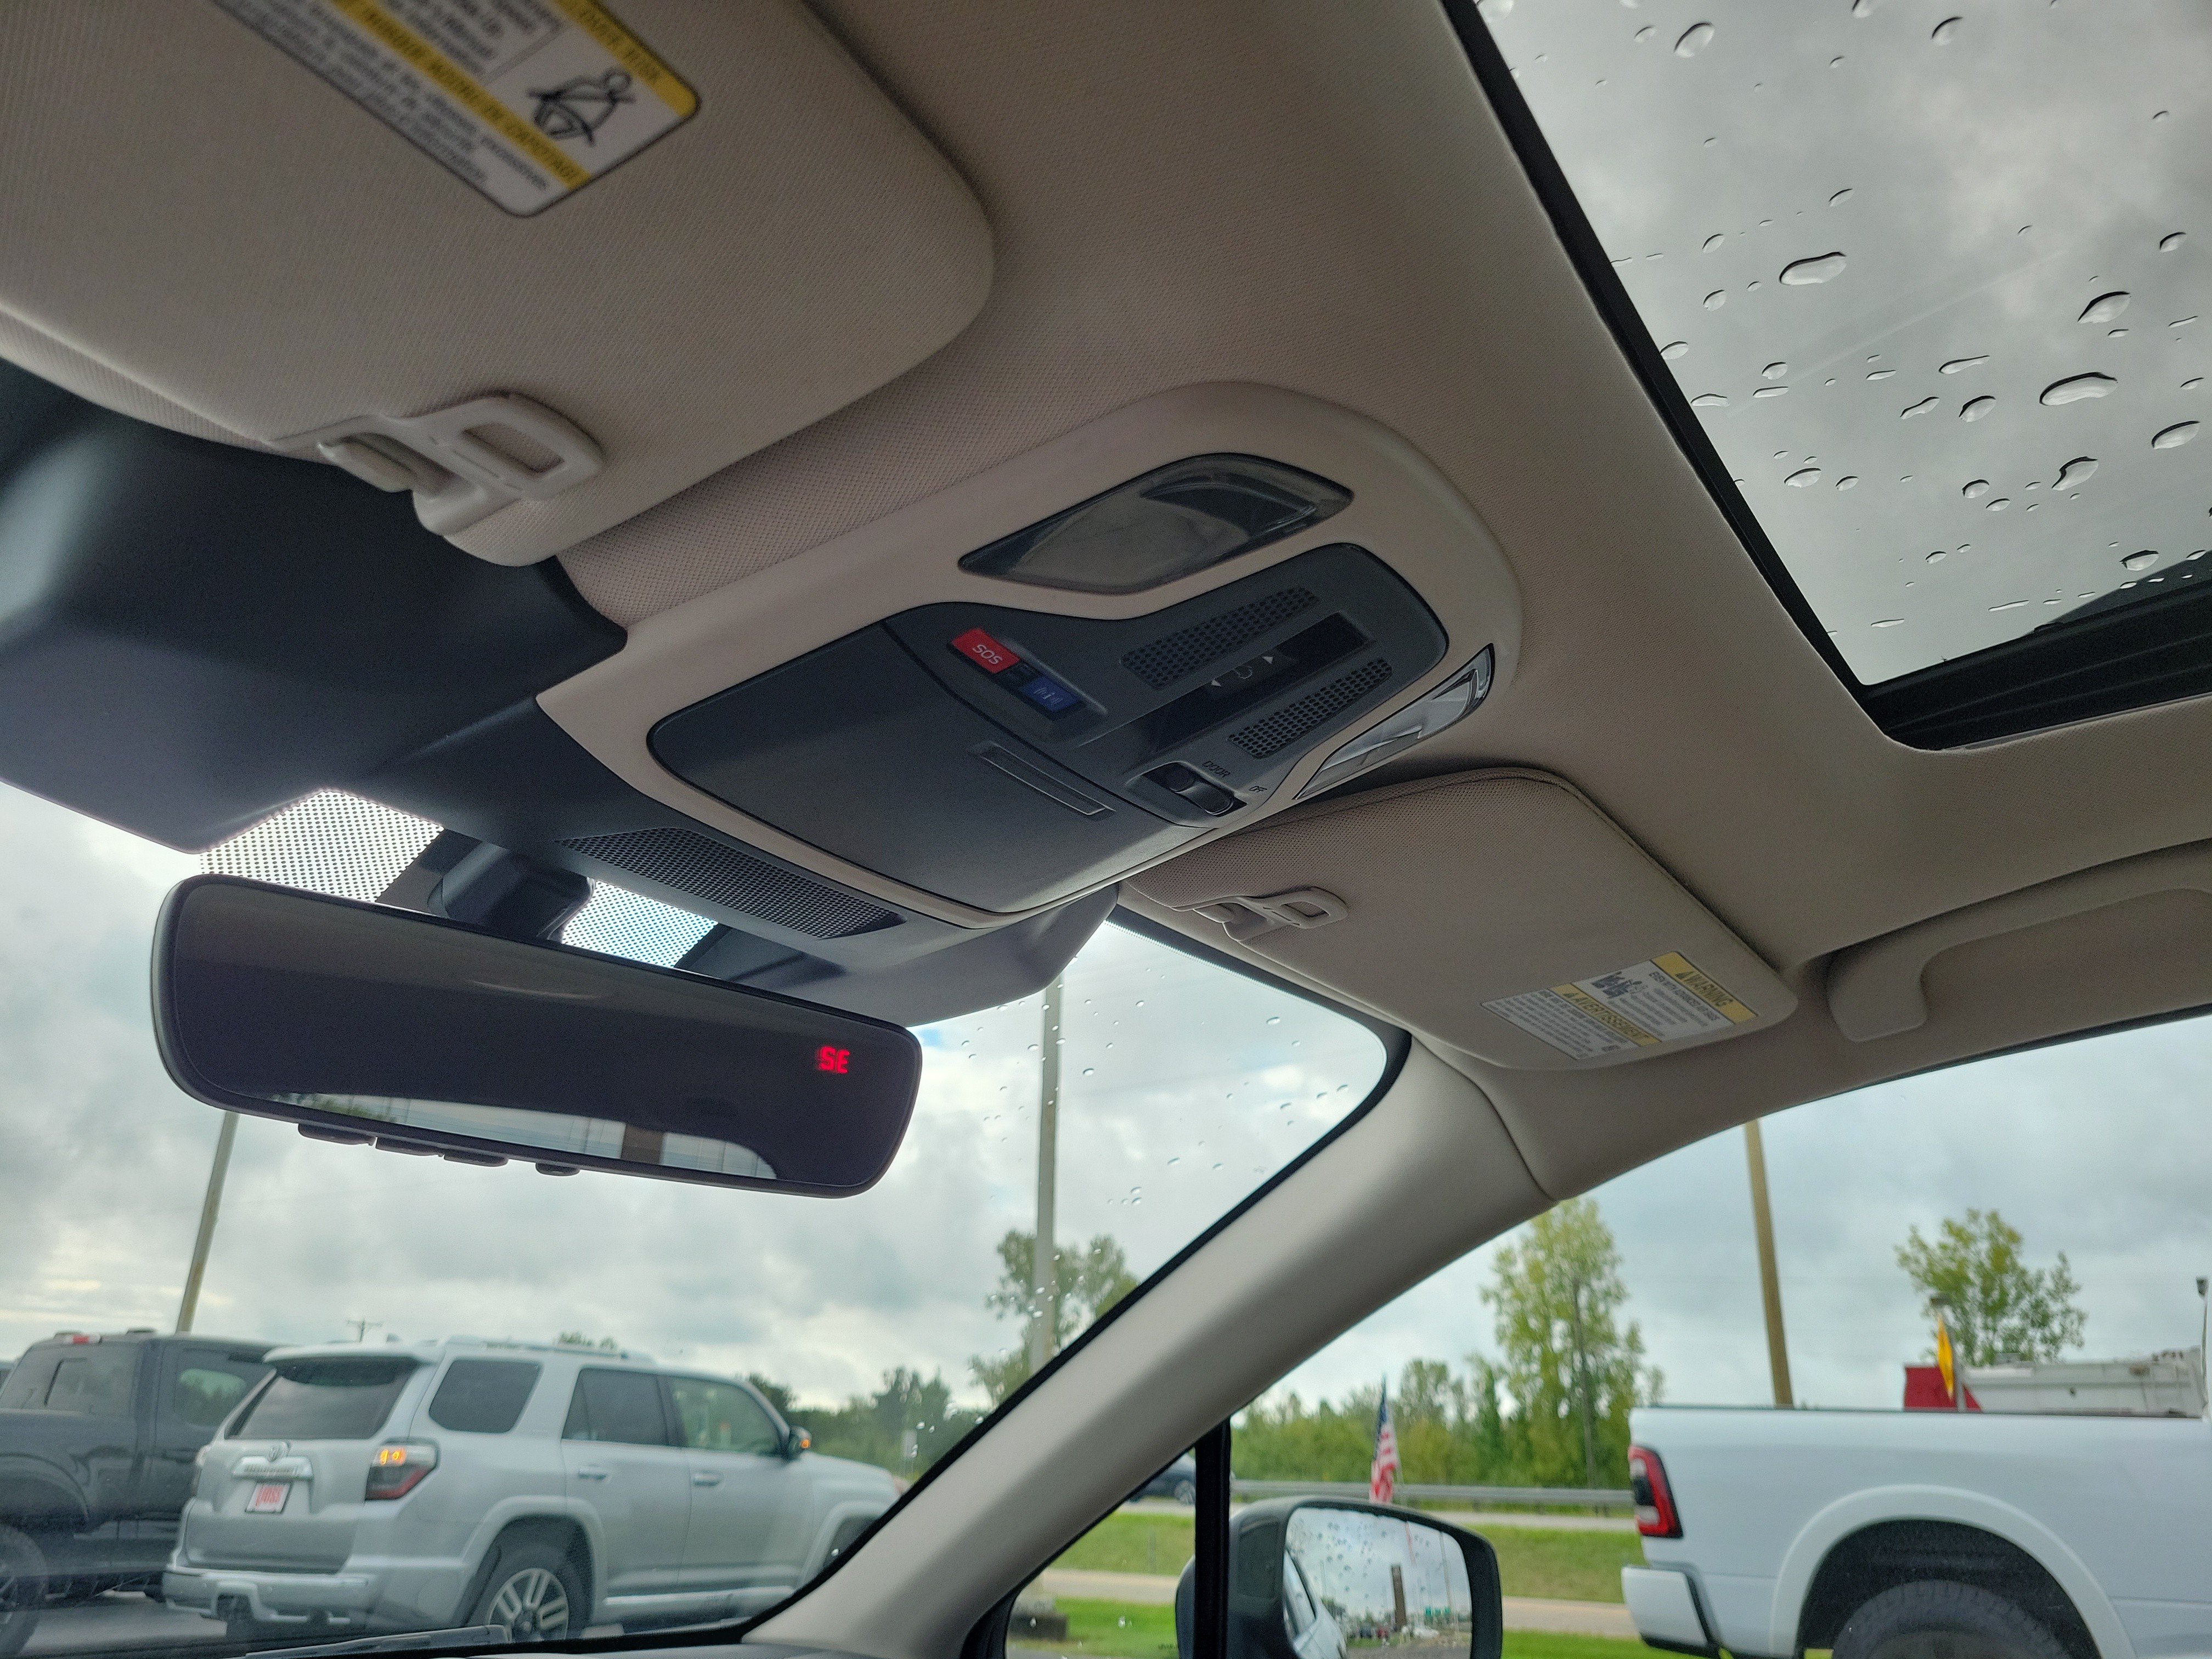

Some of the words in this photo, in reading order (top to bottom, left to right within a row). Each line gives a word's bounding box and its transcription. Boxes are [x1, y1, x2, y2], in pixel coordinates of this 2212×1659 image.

[972, 644, 1003, 665] SOS
[1202, 760, 1232, 778] DOOR
[1683, 973, 1733, 1007] WARNING
[820, 1046, 850, 1074] SE
